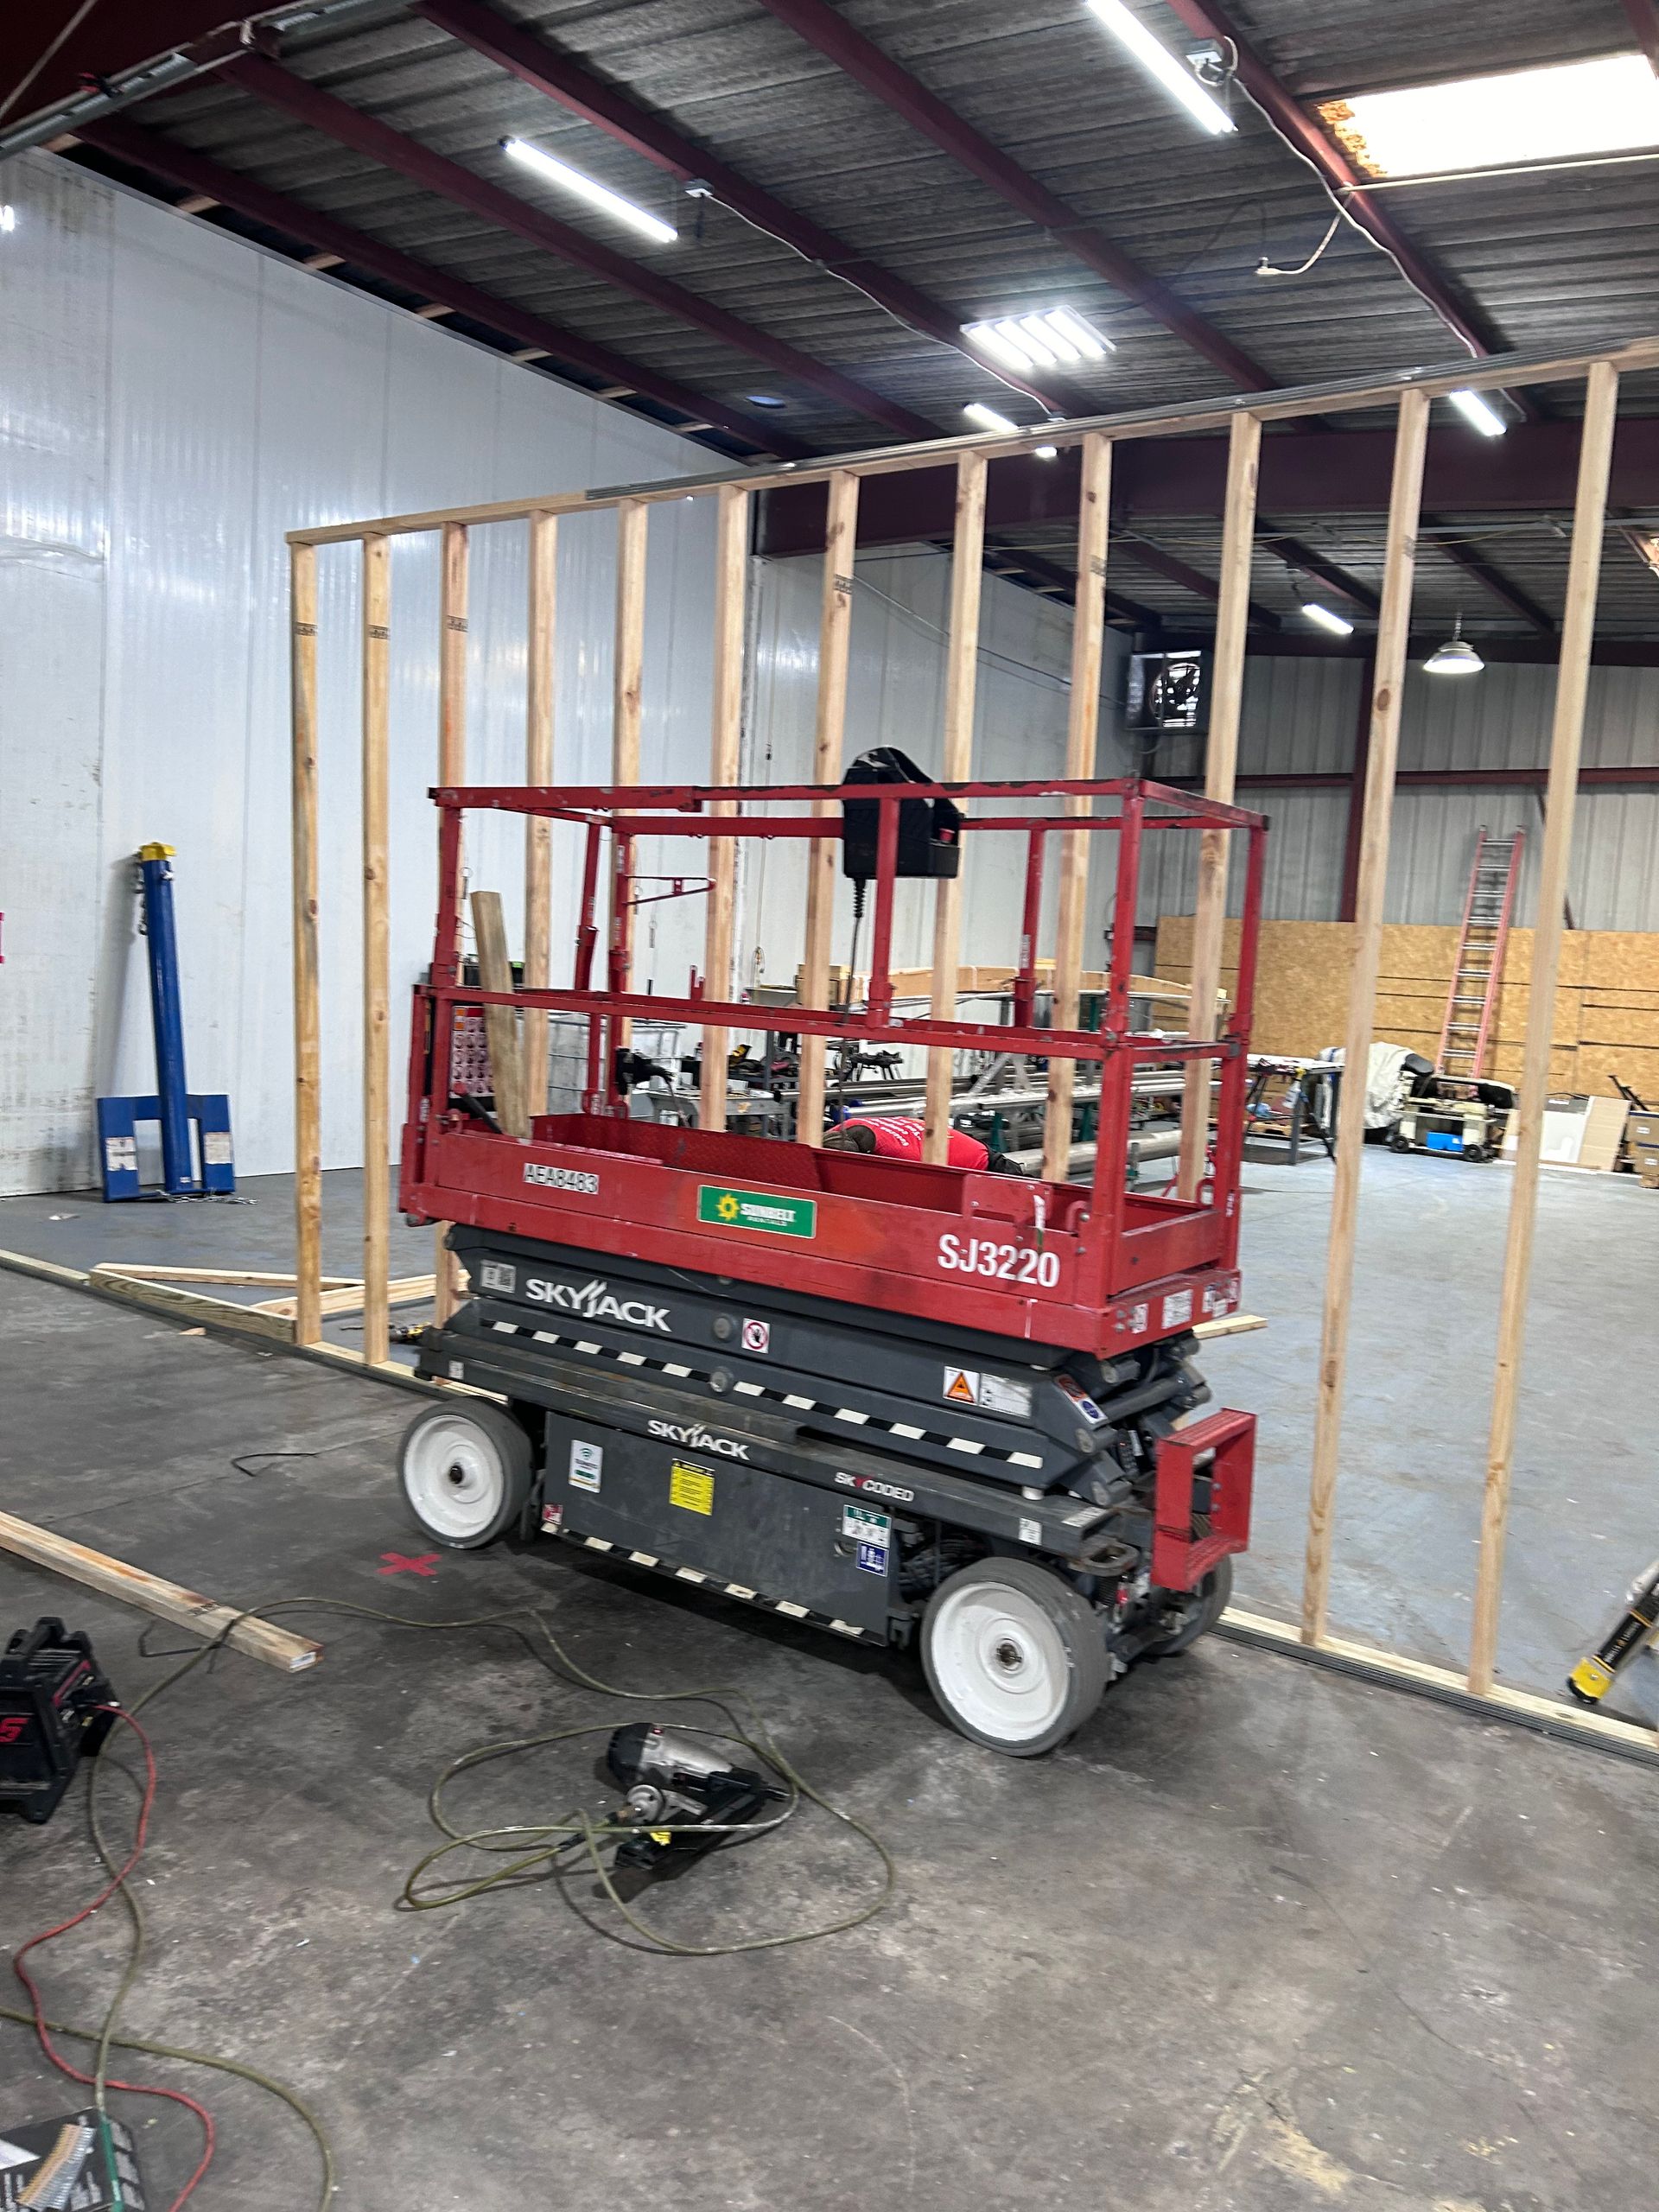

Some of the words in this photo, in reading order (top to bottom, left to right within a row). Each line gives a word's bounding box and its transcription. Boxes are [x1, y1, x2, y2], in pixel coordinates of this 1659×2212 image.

[524, 1164, 598, 1193] AEA8483
[938, 1233, 1061, 1287] SJ3220
[525, 1279, 672, 1332] SKYJACK
[647, 1419, 750, 1460] SKYJACK
